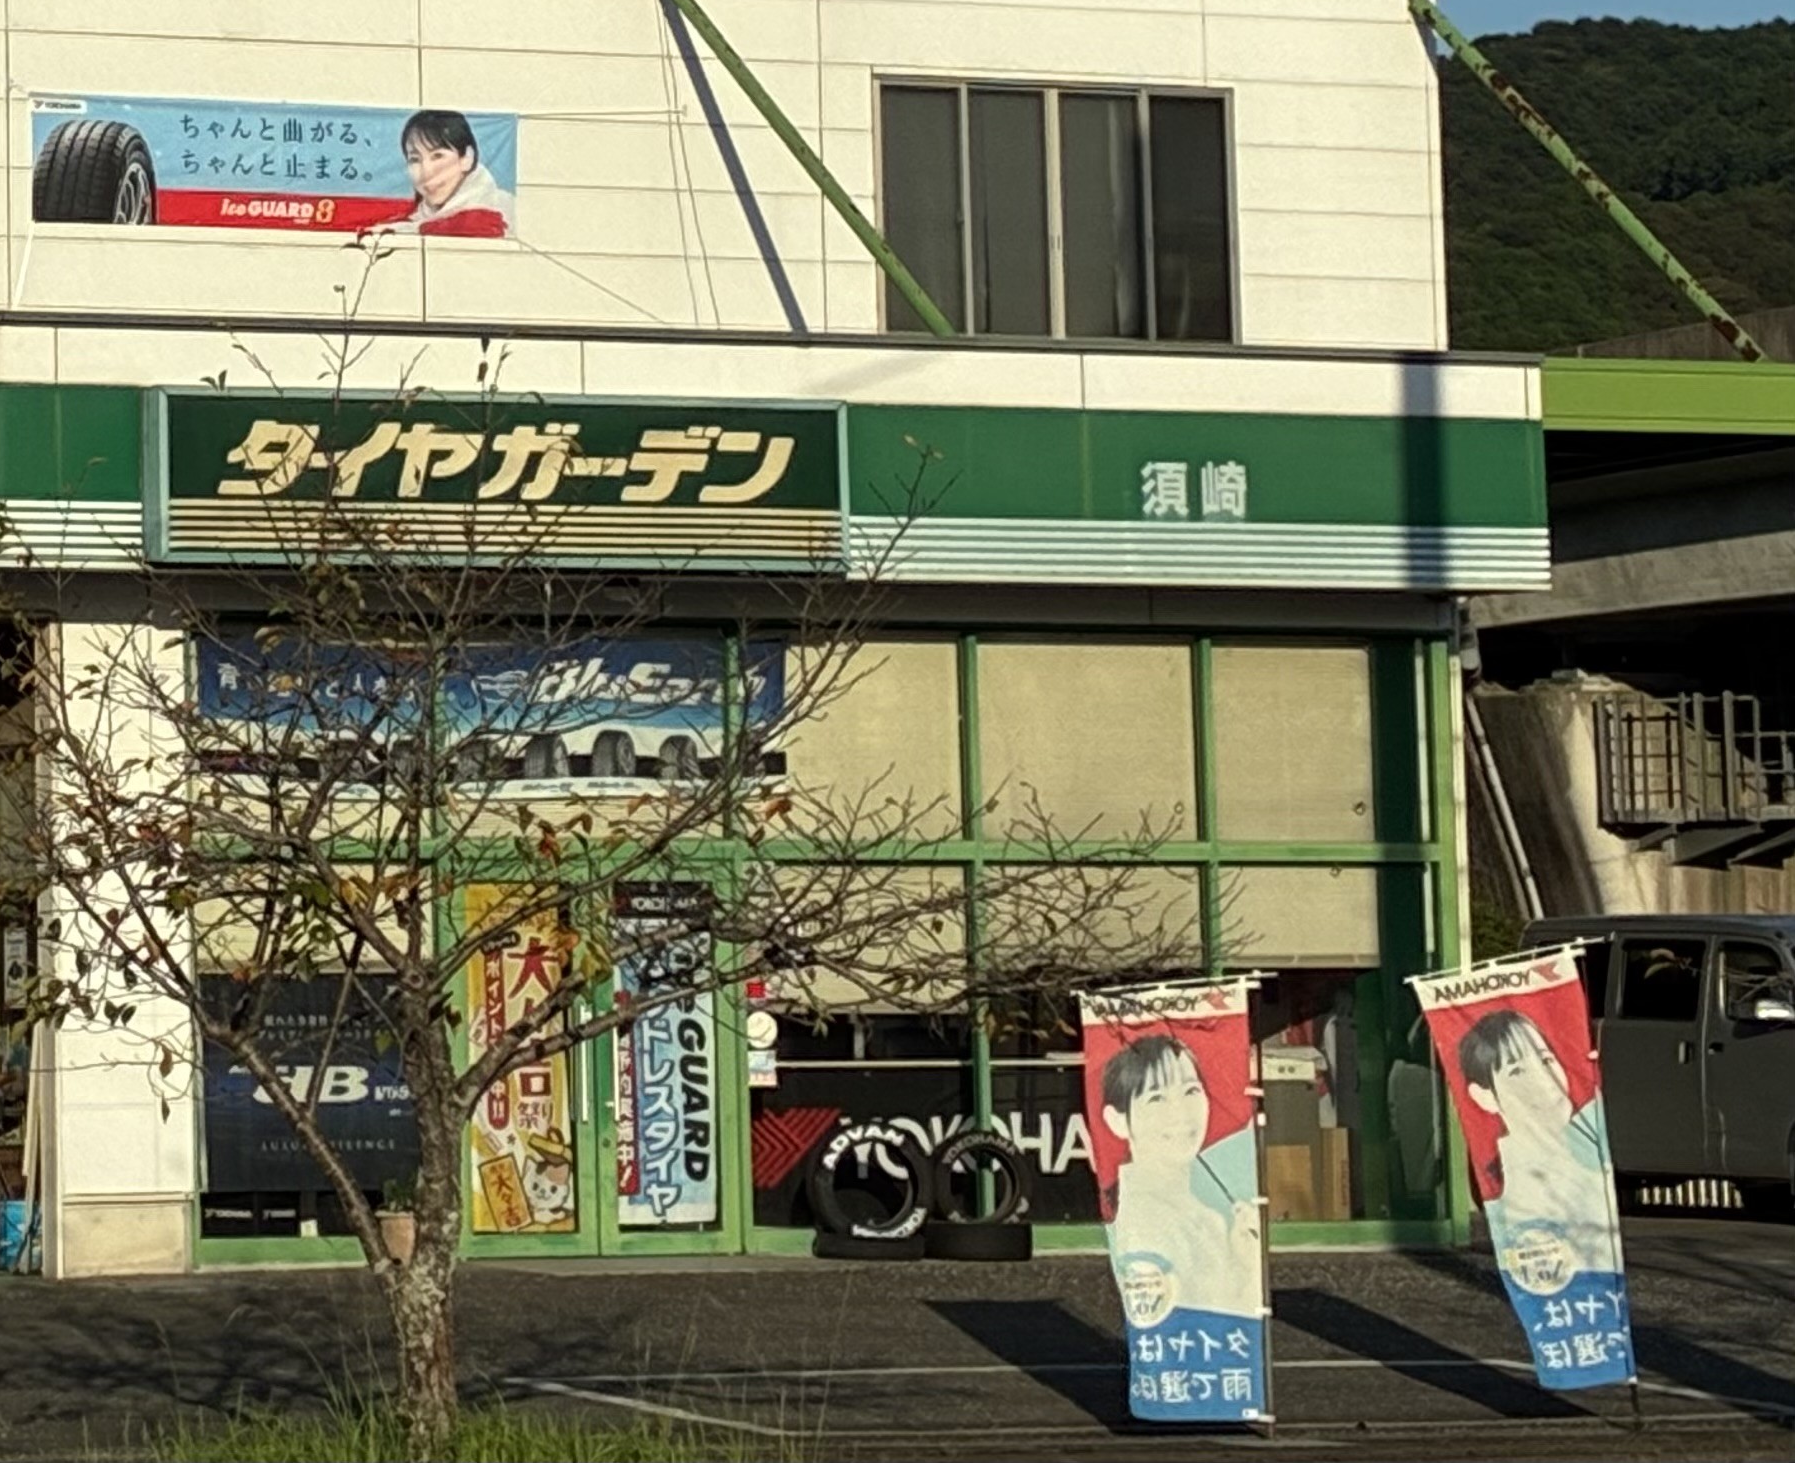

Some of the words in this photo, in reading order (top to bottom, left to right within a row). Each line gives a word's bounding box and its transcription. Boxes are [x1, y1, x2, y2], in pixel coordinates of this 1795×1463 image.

[179, 114, 372, 147] ちゃんと曲がる、
[181, 149, 374, 183] ちゃんと止まる。
[216, 419, 795, 504] タイヤガーデン
[1140, 459, 1248, 518] 須崎
[822, 1124, 906, 1171] ADVAN
